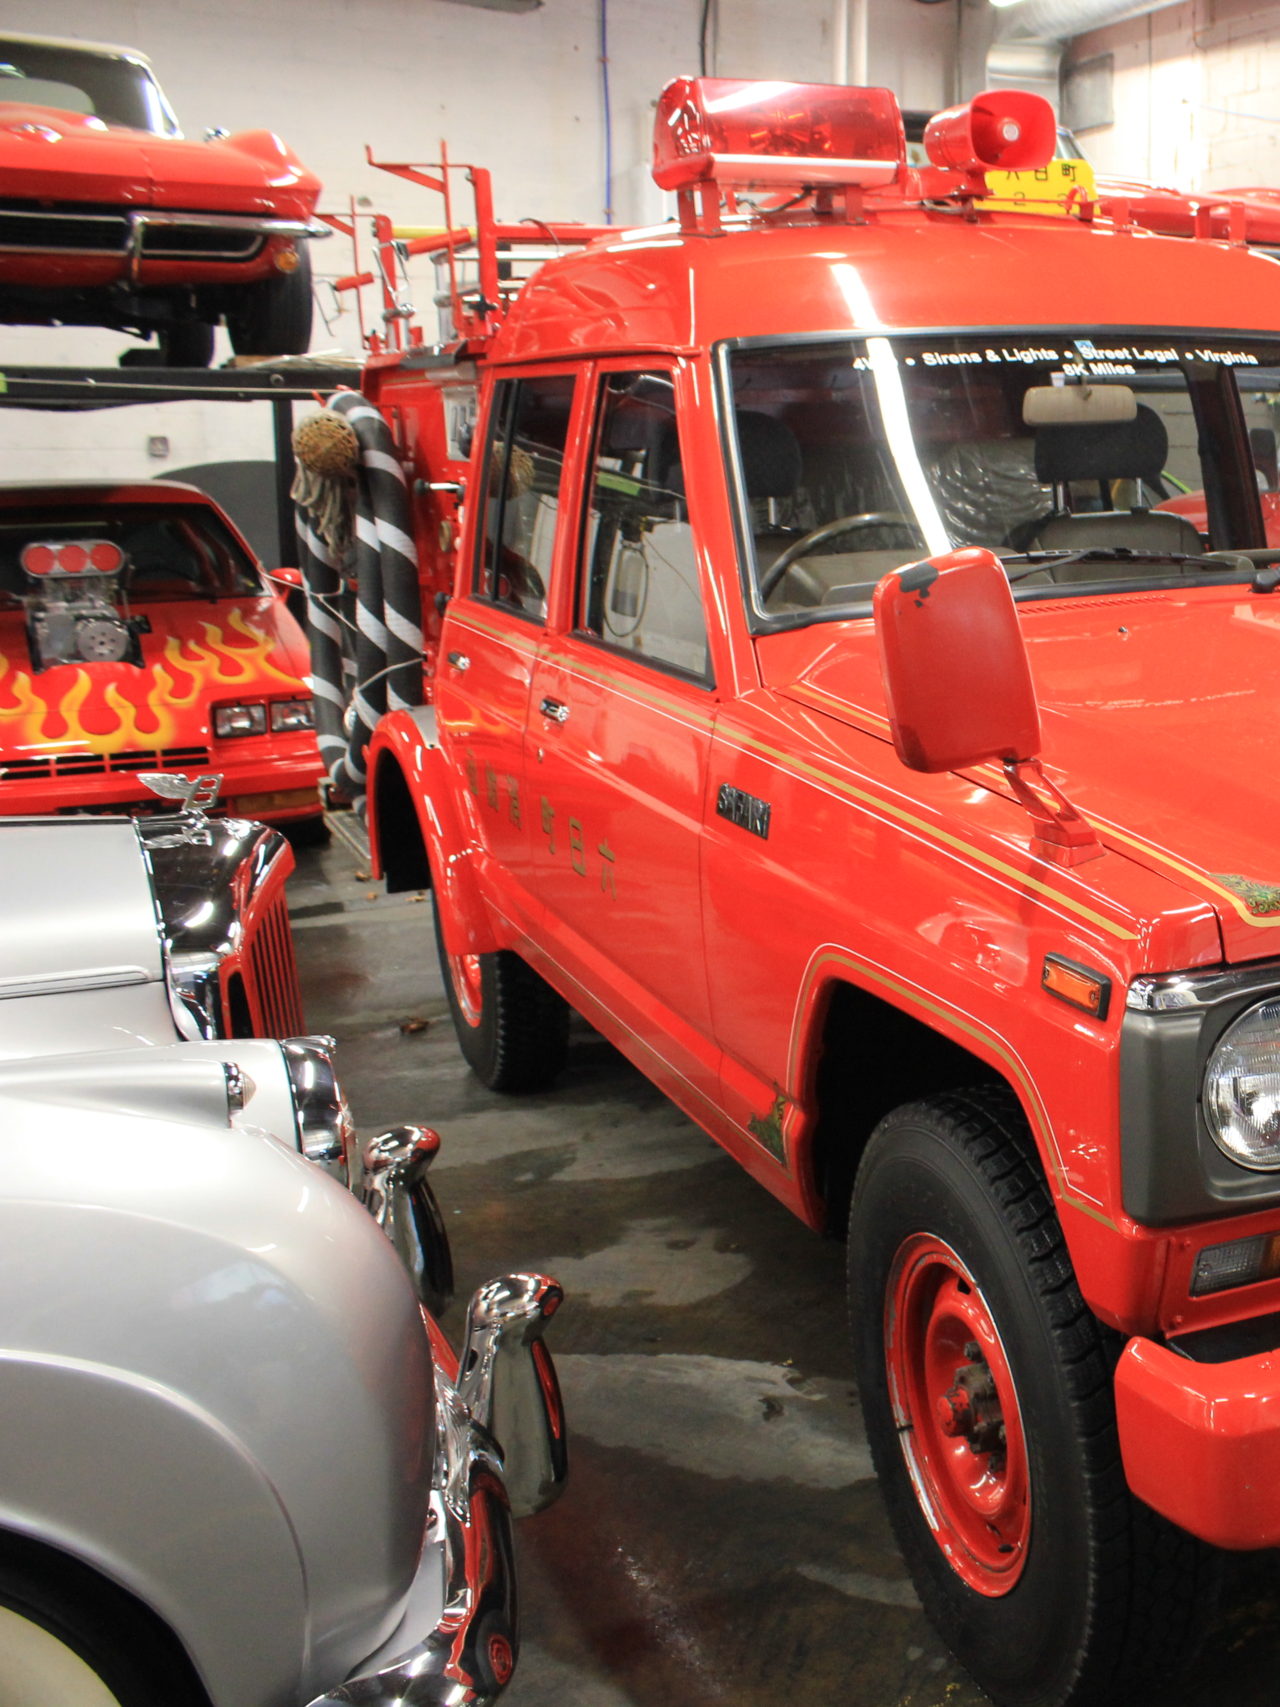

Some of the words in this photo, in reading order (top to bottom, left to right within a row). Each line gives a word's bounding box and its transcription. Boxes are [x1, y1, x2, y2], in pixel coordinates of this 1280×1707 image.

[921, 349, 982, 366] Sirens
[985, 347, 1001, 362] &
[1002, 347, 1059, 364] Lights
[1082, 347, 1133, 361] Street
[1135, 347, 1179, 361] Legal
[1196, 349, 1260, 366] Virginia
[1062, 363, 1089, 376] 8K
[1091, 362, 1136, 376] Miles
